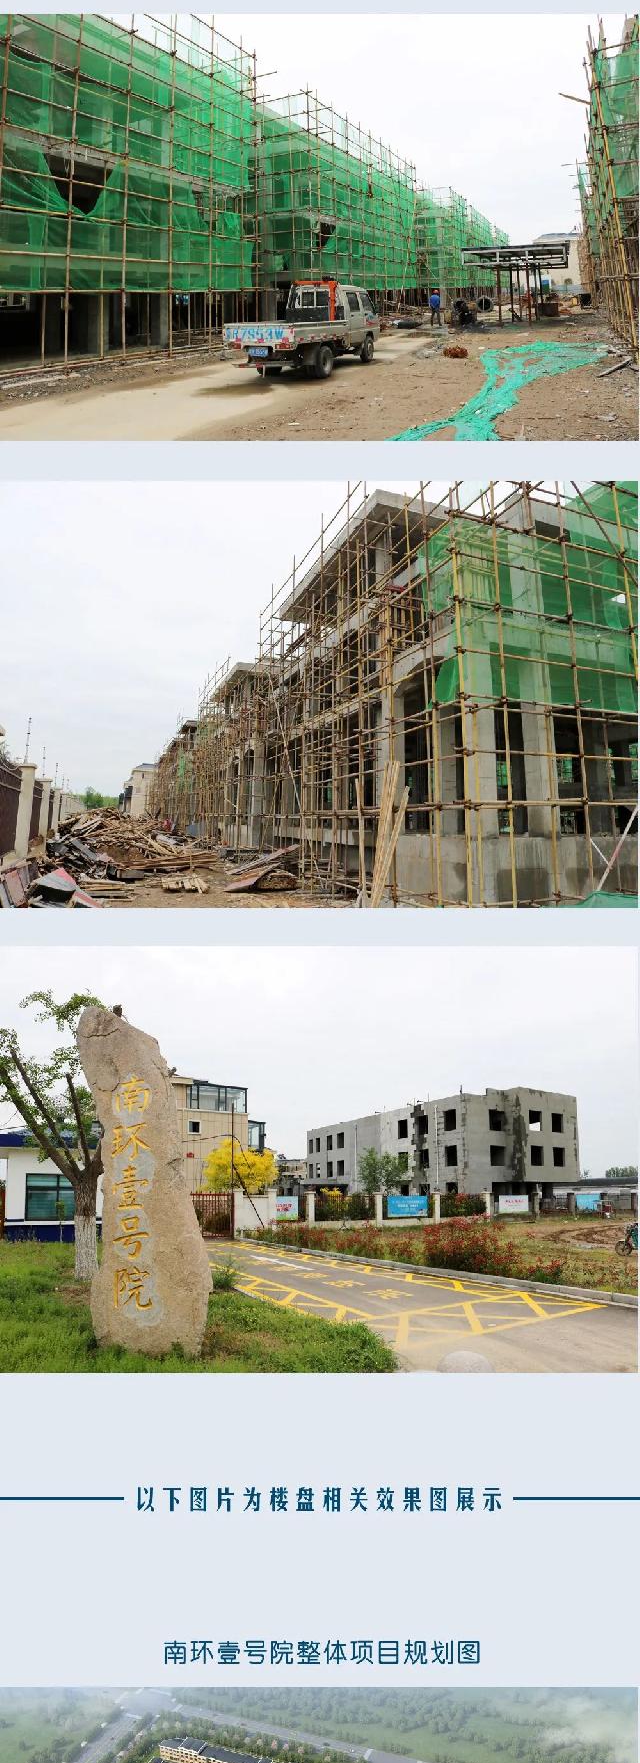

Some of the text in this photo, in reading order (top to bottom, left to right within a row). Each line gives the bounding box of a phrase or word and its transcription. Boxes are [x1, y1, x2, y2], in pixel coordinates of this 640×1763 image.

[112, 1076, 153, 1311] 南环壹号院
